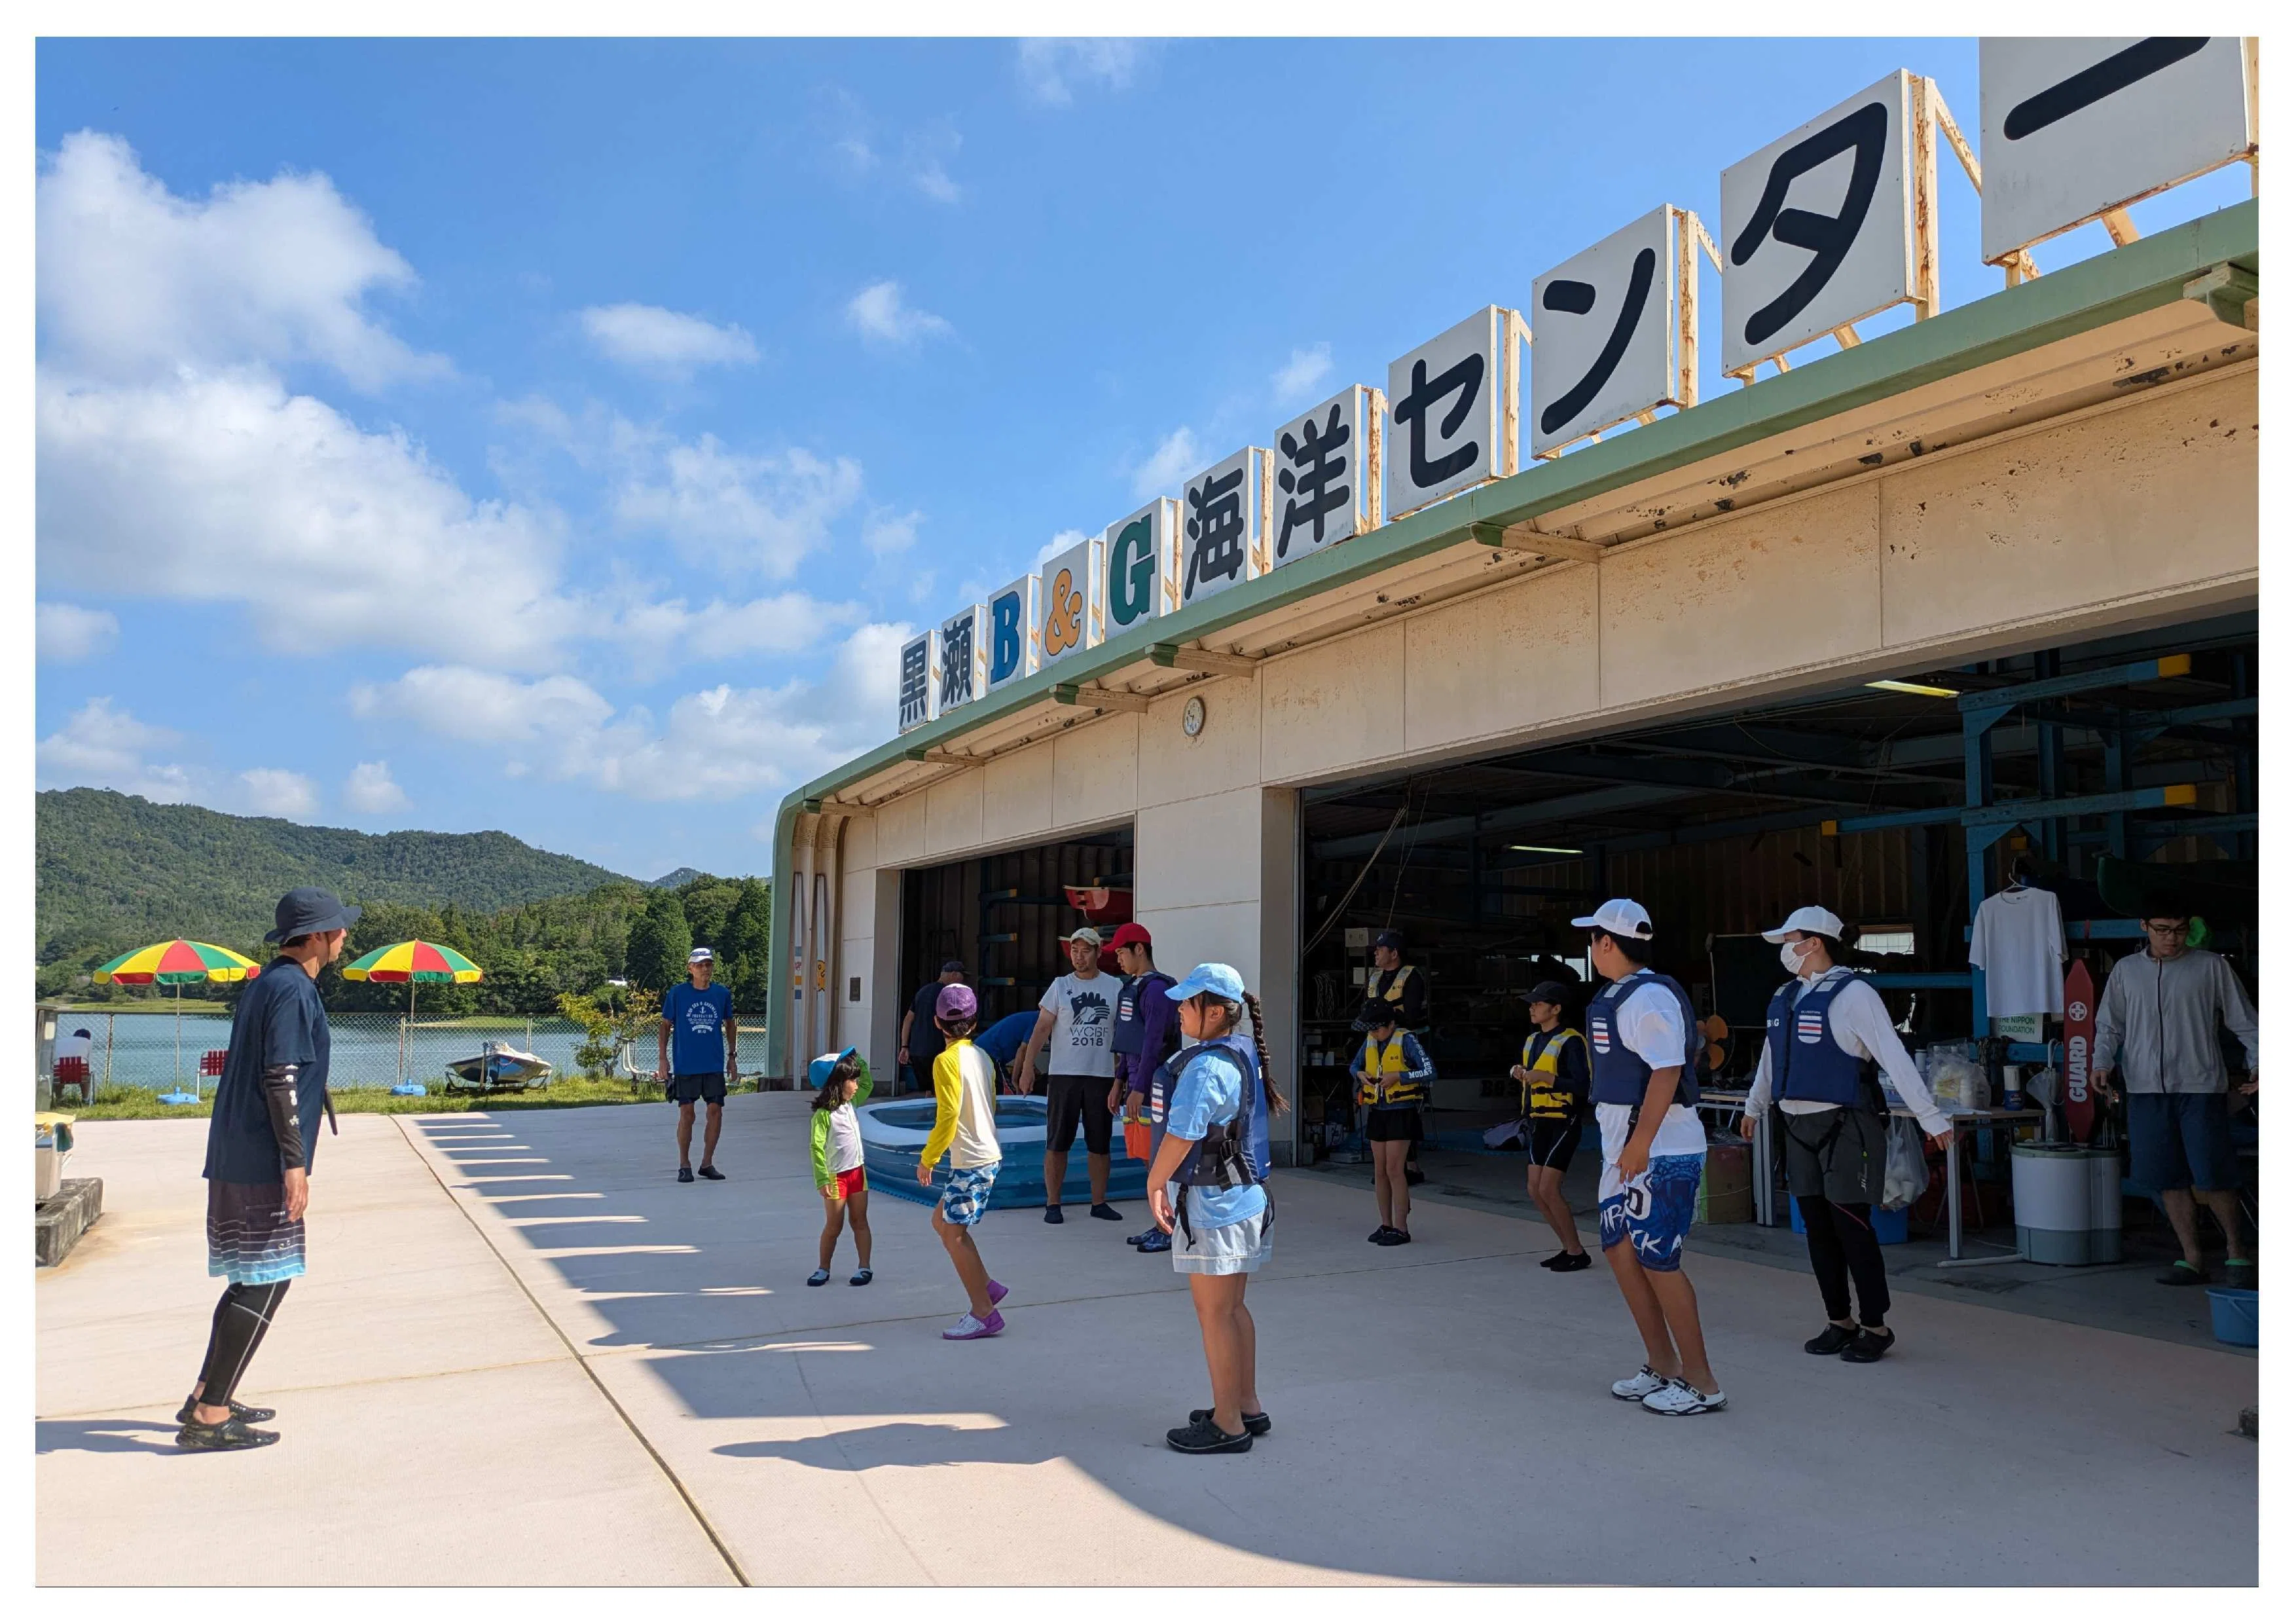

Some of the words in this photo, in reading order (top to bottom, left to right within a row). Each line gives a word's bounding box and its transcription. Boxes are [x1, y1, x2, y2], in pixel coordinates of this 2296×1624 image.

[1069, 1026, 1108, 1037] WCBF
[1998, 1025, 2035, 1034] FOUNDATION
[1072, 1037, 1104, 1046] 2018
[2069, 1035, 2087, 1103] GUARD
